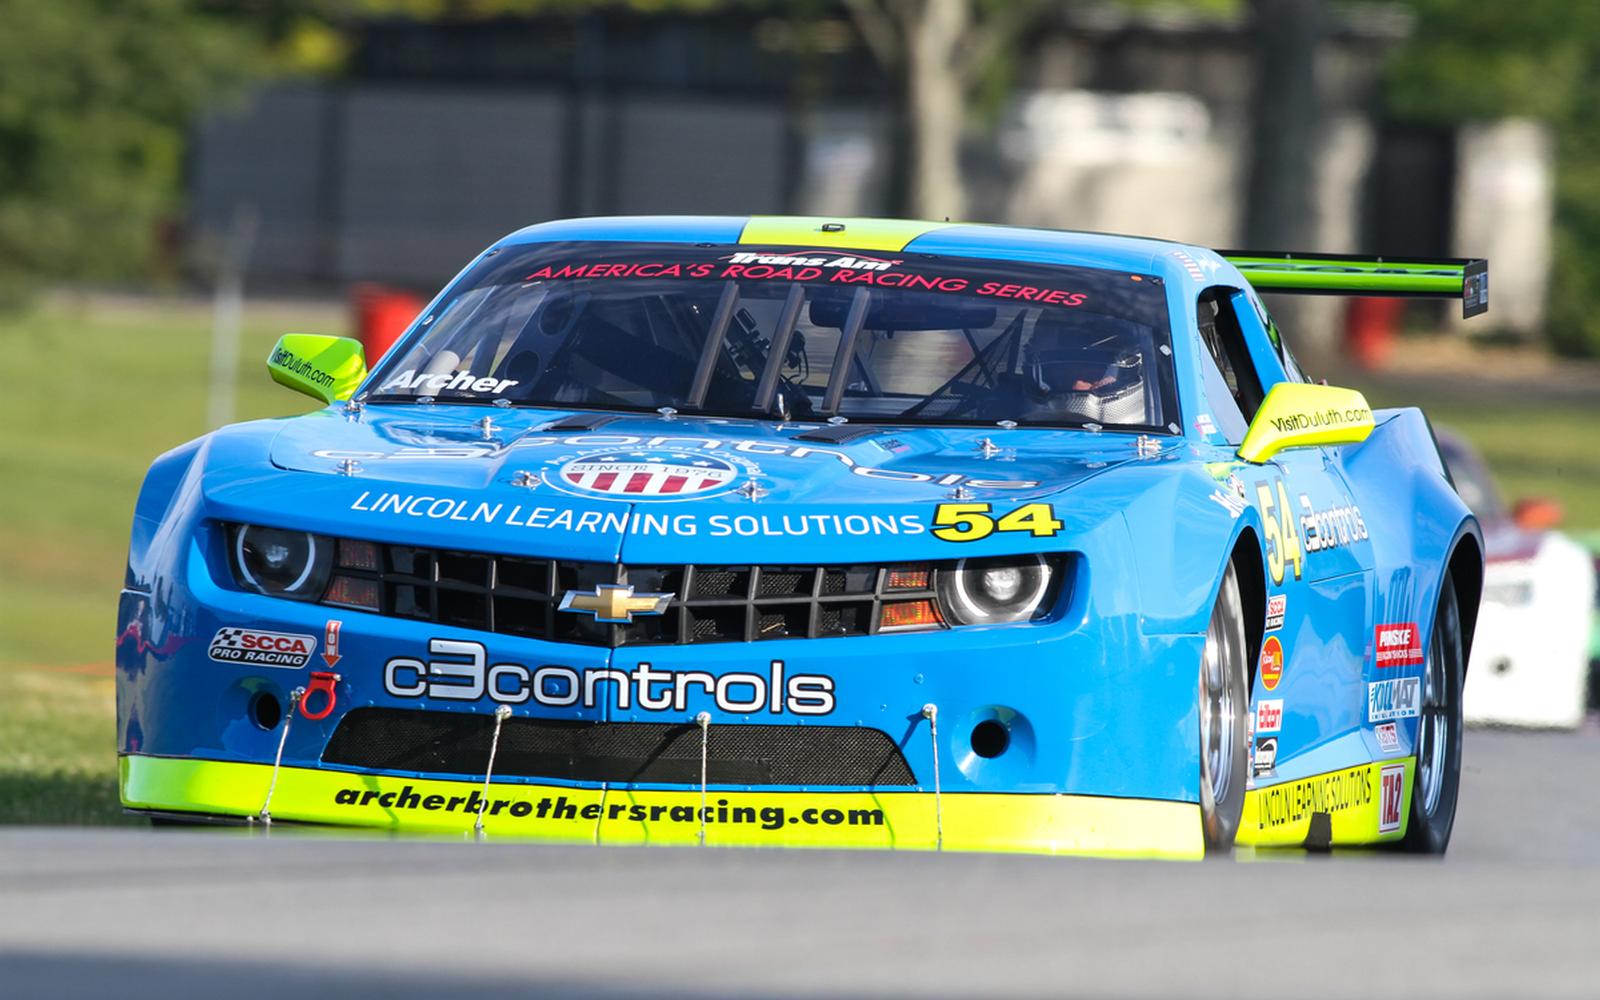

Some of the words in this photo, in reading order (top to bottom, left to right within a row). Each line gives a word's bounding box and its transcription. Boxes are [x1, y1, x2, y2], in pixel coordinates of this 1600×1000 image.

[729, 252, 822, 268] Trans
[823, 256, 893, 271] Am
[526, 263, 714, 281] AMERICA'S
[721, 265, 822, 282] ROAD
[830, 269, 969, 292] RACING
[976, 282, 1088, 307] SERIES
[383, 369, 519, 394] Archer
[1270, 406, 1372, 433] VisitDuluth.com
[571, 464, 648, 472] SINCE
[662, 466, 724, 479] 1976
[351, 490, 503, 524] LINCOLN
[506, 505, 697, 536] LEARNING
[709, 515, 925, 536] SOLUTIONS
[929, 503, 1065, 543] 54
[1255, 476, 1302, 587] 54
[211, 648, 242, 659] PRO
[244, 651, 305, 665] RACING
[241, 634, 307, 653] SCCA
[384, 638, 835, 715] c3controls
[334, 785, 884, 830] archerbrothersracing.com
[1382, 772, 1402, 825] TA2
